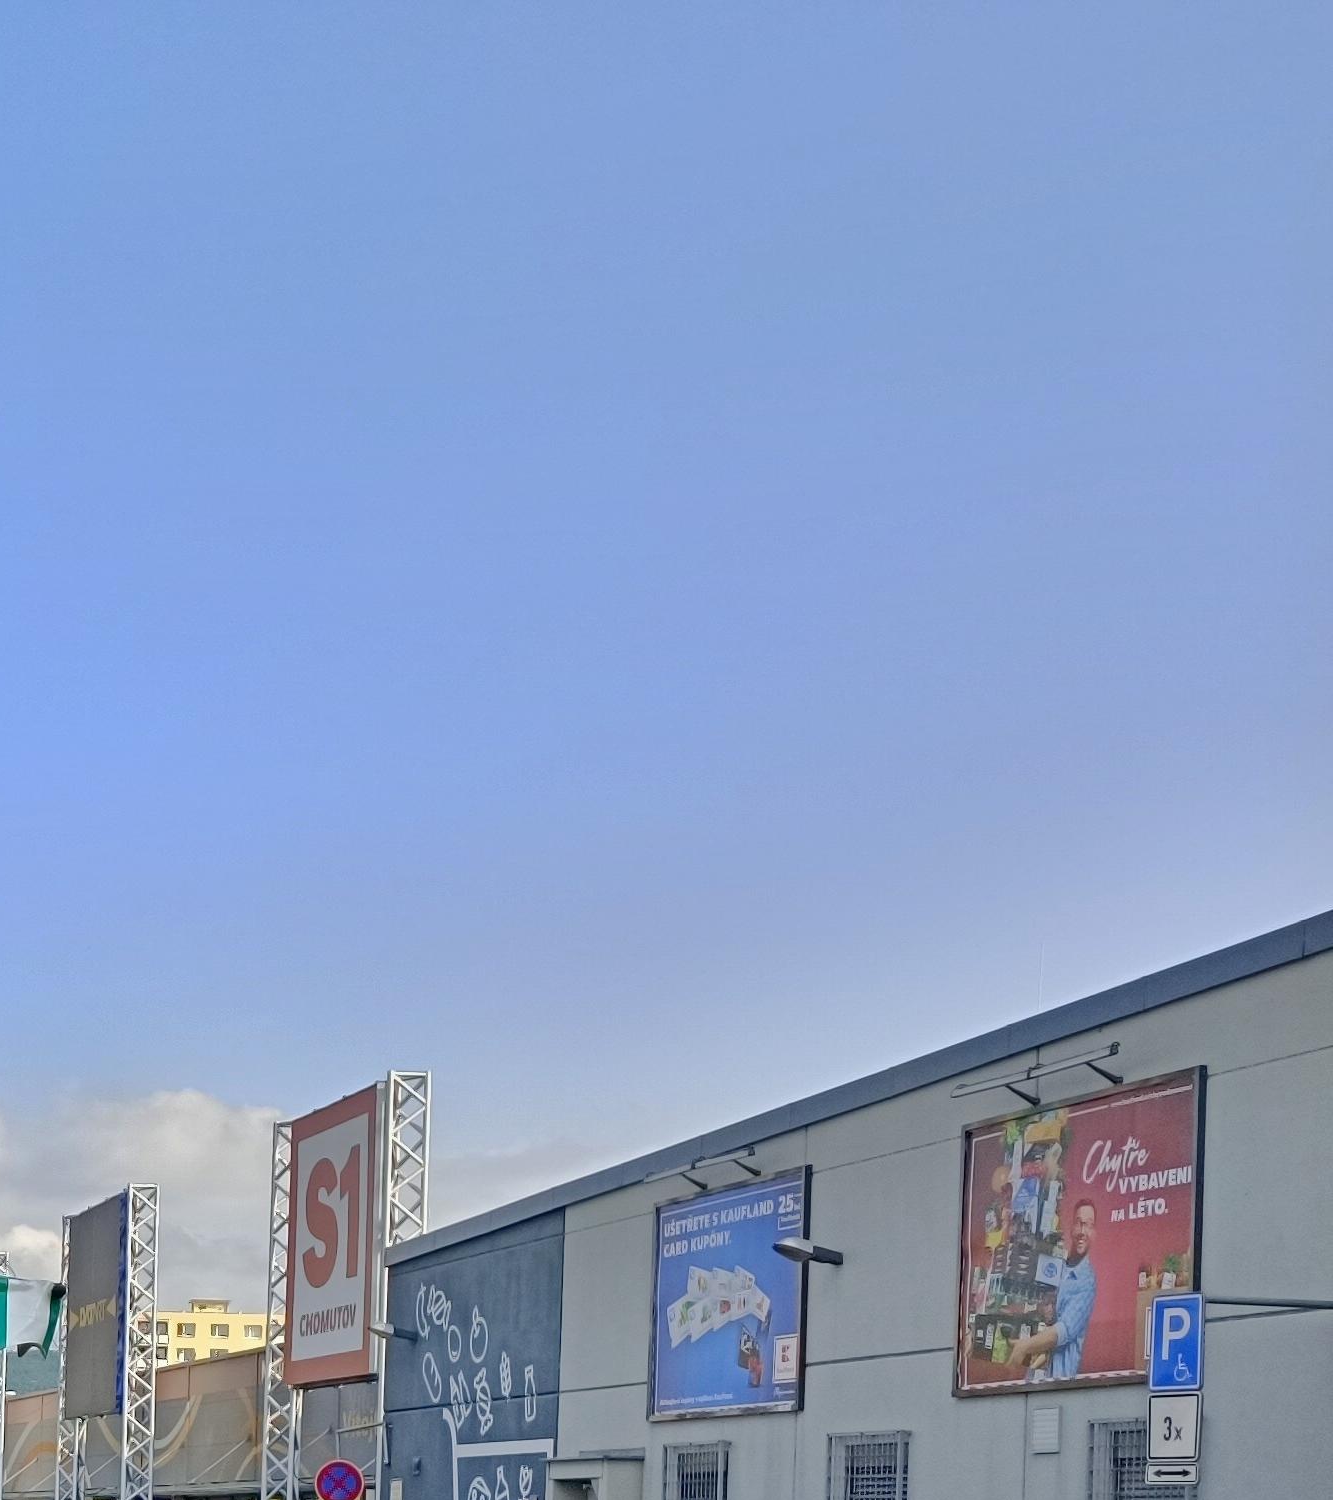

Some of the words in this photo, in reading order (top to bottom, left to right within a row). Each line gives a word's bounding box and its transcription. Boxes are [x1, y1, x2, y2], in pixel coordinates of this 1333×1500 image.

[1083, 1136, 1150, 1192] Chytře
[302, 1143, 361, 1289] S1
[720, 1199, 774, 1225] KAUFLAND
[777, 1193, 794, 1214] 25
[1110, 1208, 1125, 1222] NA
[1128, 1195, 1169, 1219] LÉTO.
[663, 1241, 689, 1258] CARD
[299, 1304, 357, 1337] CHOMUTOV
[1161, 1307, 1191, 1361] P
